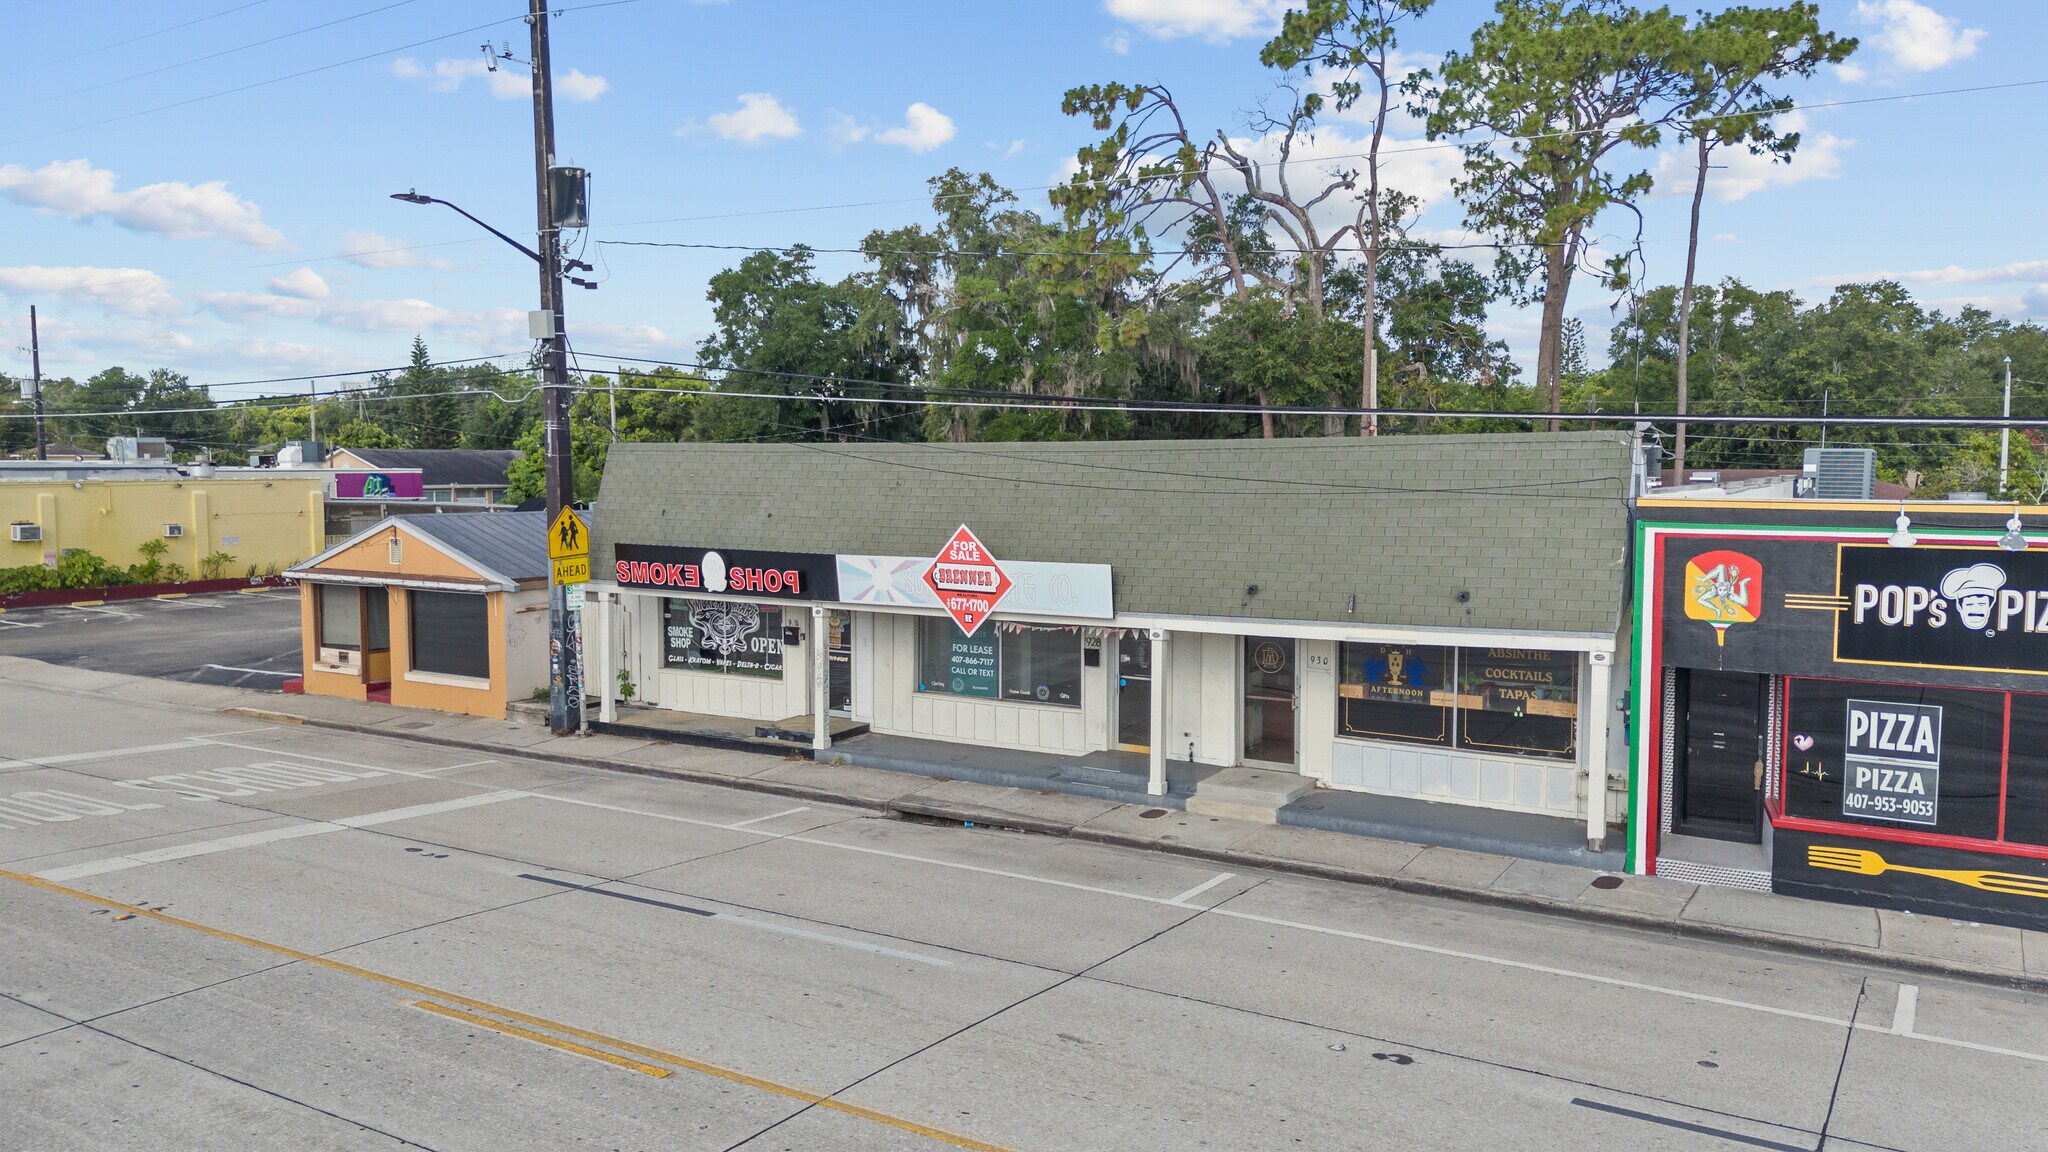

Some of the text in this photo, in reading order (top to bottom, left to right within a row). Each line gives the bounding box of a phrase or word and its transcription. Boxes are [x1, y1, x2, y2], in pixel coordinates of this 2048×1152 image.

[953, 541, 977, 551] FOR
[950, 550, 980, 561] SALE
[556, 564, 586, 578] AHEAD
[616, 560, 800, 594] SMOKE SHOP
[939, 568, 993, 586] BRENNER
[667, 626, 693, 638] SMOKE
[670, 637, 691, 648] SHOP
[751, 637, 783, 654] OPEN
[1085, 637, 1101, 647] 928
[952, 644, 993, 655] FOR LEASE
[1488, 648, 1551, 661] ABSINTHE
[951, 656, 994, 666] 407-866-7117
[1310, 655, 1329, 665] 930
[764, 662, 783, 671] CIGAR
[951, 667, 994, 677] CALL OR TEXT
[1485, 668, 1553, 682] COCKTAILS
[1370, 686, 1423, 697] AFTERNOON
[1499, 688, 1538, 700] TAPAS
[1849, 709, 1935, 754] PIZZA
[112, 760, 391, 801] SCHOOL
[1856, 766, 1925, 795] PIZZA
[1846, 793, 1933, 816] 407-953-9053
